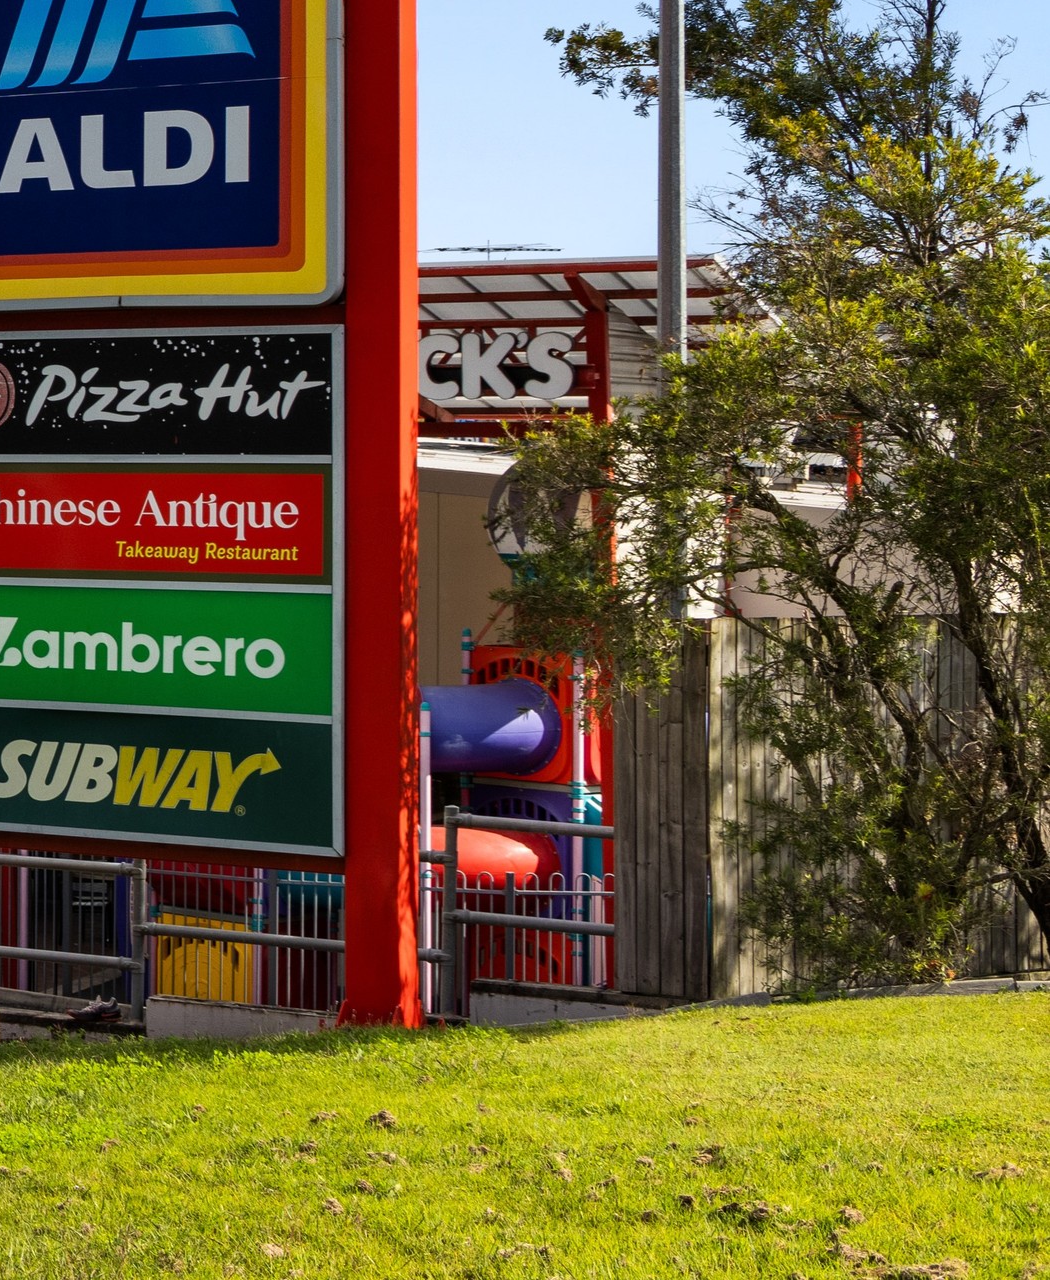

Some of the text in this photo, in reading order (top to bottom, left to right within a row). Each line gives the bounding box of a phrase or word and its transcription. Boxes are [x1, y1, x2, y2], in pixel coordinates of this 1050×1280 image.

[25, 362, 325, 427] Pizza Hut
[134, 489, 299, 541] Antique
[115, 540, 299, 564] Takeaway Restaurant
